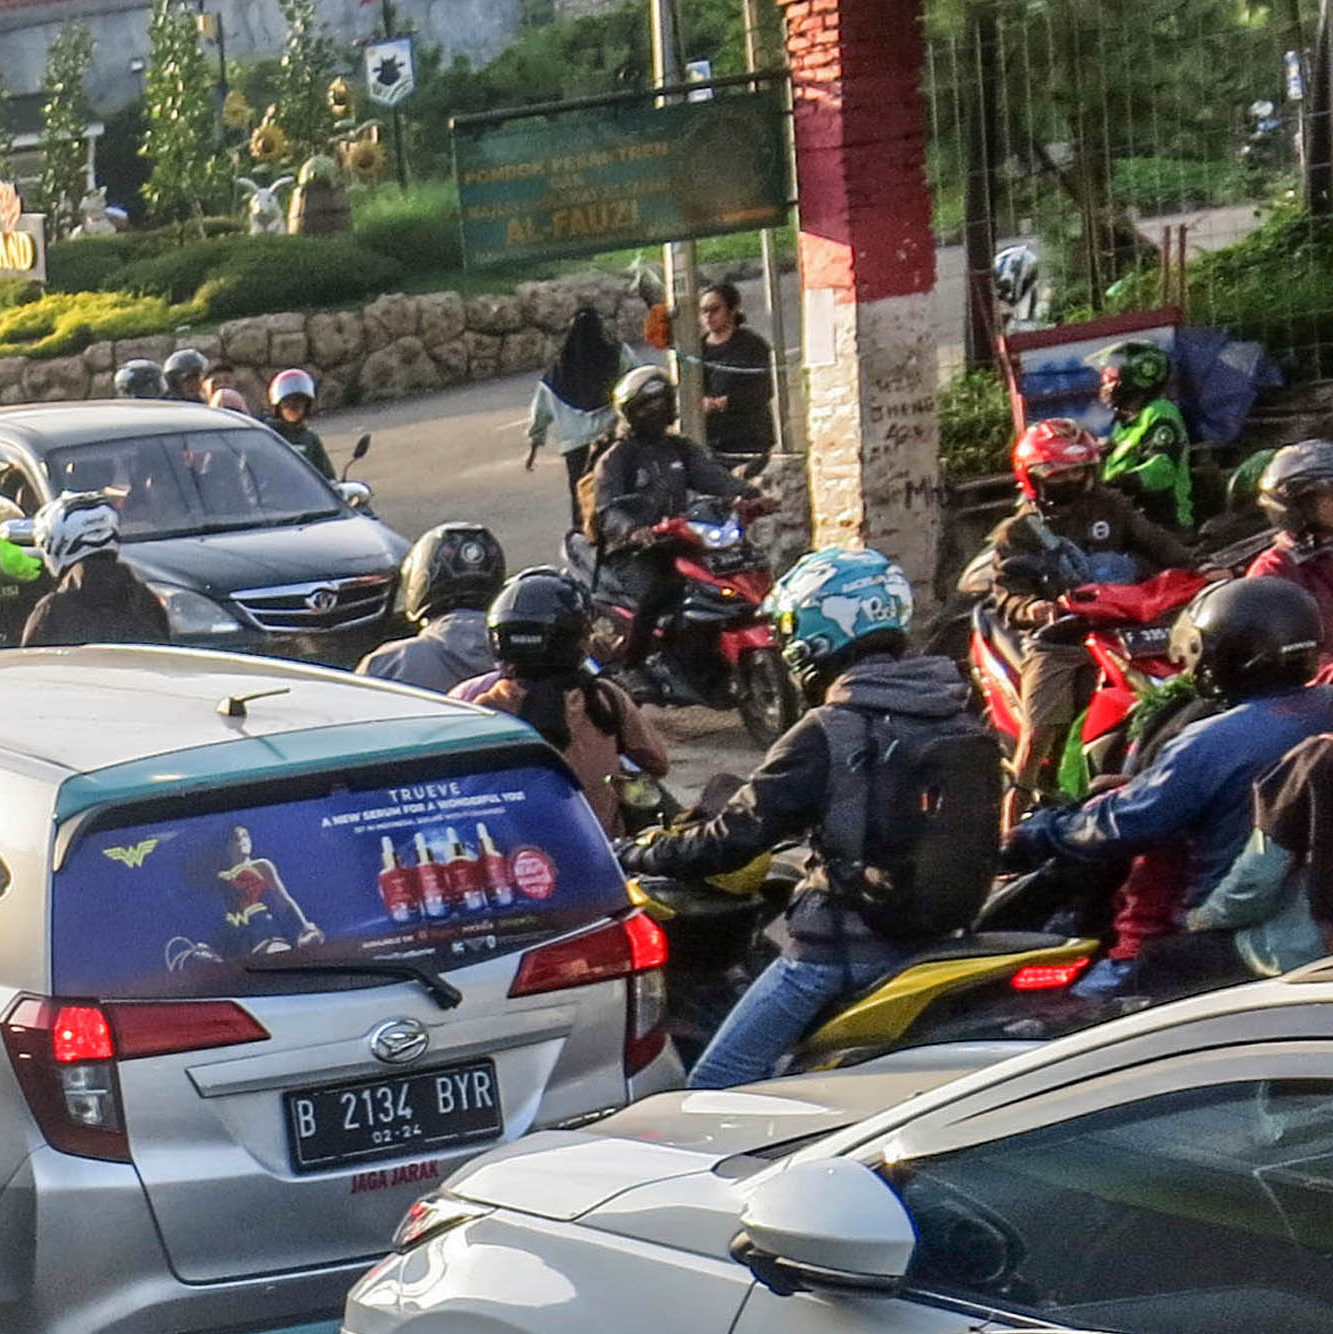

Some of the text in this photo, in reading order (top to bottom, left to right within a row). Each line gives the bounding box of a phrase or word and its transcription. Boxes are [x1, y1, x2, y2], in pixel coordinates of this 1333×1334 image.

[389, 782, 462, 802] TRUEVE
[321, 817, 332, 828] A
[333, 812, 361, 826] NEW
[363, 806, 401, 821] SERUM
[403, 803, 426, 815] FOR
[427, 801, 437, 811] A
[437, 794, 501, 810] WONDERFUL
[297, 1071, 493, 1138] B 2134 BYR
[350, 1160, 440, 1194] JAGA JARAK
